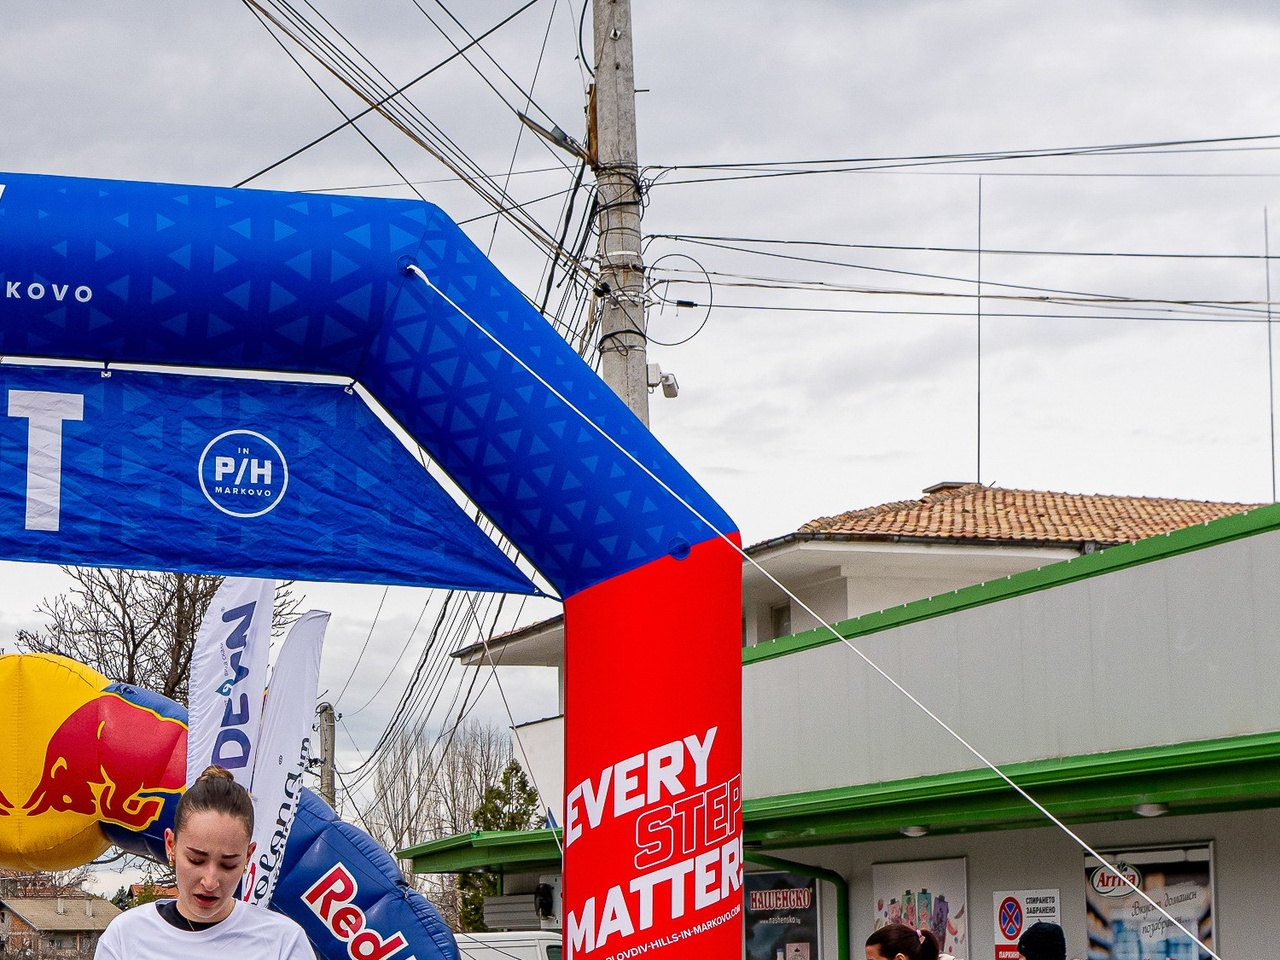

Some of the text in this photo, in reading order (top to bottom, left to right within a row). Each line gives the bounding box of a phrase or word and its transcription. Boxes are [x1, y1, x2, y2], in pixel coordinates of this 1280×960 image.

[238, 447, 250, 455] IN
[215, 456, 272, 486] P/H
[215, 486, 272, 497] MARKOVO
[567, 726, 718, 849] EVERY
[634, 773, 742, 870] STEP
[750, 888, 810, 911] НАШЕНСКО
[1026, 896, 1055, 905] СПИРАНЕТО
[1026, 906, 1056, 915] ЗАБРАНЕНО
